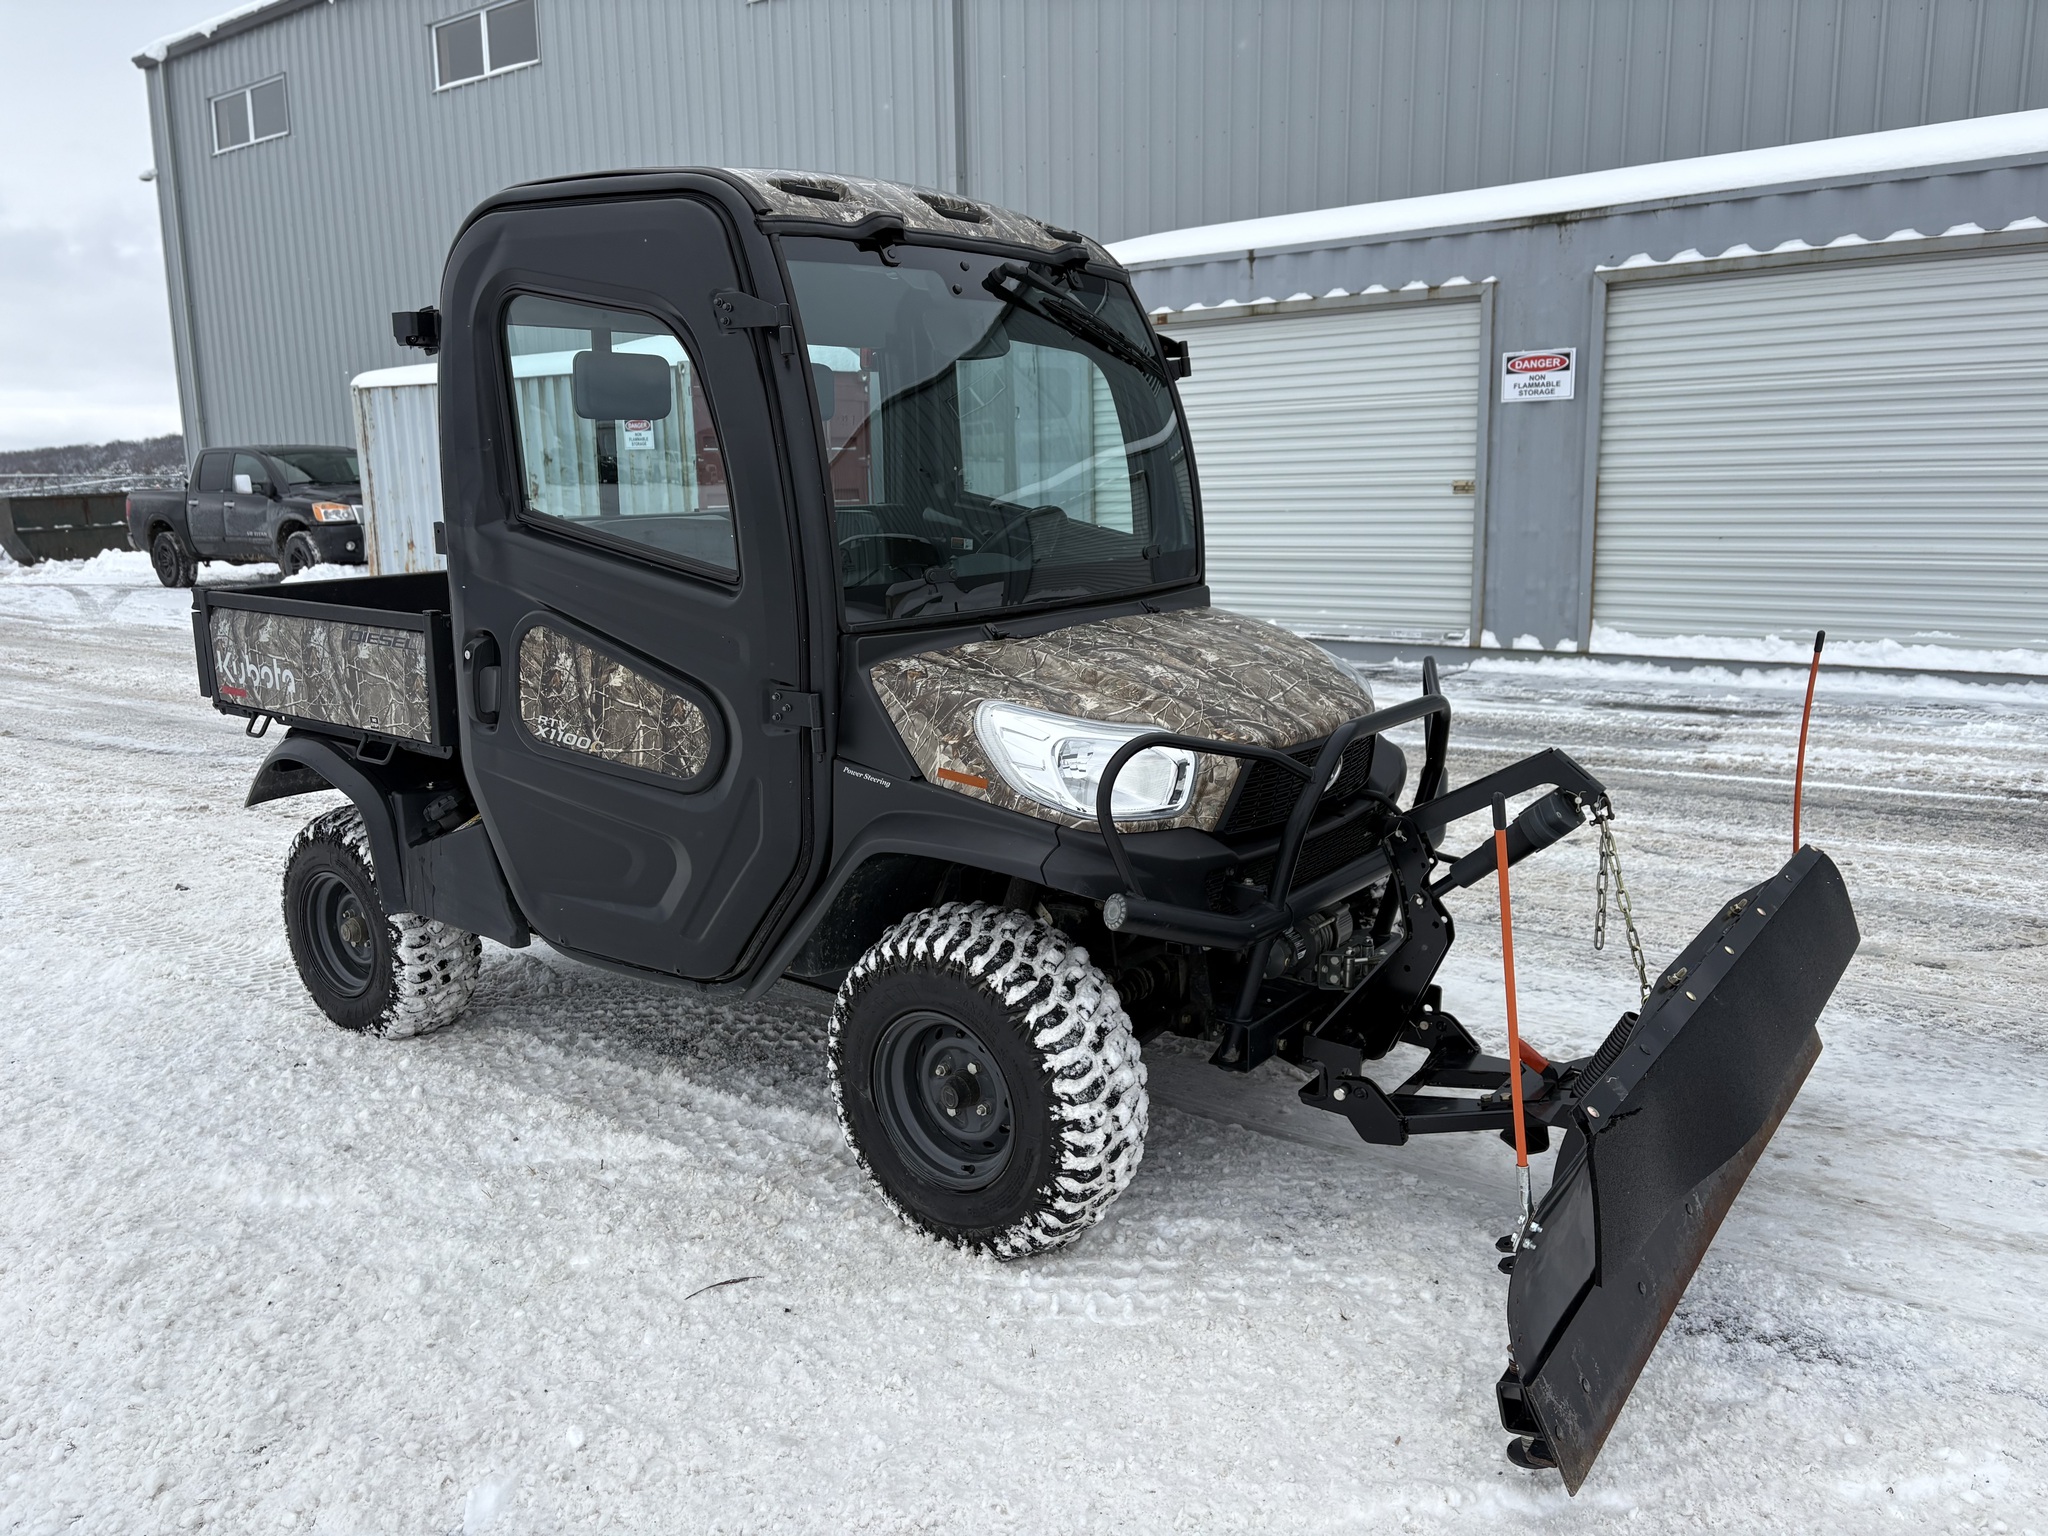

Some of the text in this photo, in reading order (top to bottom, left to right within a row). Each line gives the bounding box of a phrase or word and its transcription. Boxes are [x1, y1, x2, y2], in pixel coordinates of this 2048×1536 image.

[1515, 358, 1561, 370] DANGER
[1513, 380, 1561, 390] FLAMMABLE
[1518, 388, 1556, 397] STORAGE
[348, 630, 418, 651] DIESEL
[216, 650, 296, 694] Kubota
[538, 715, 569, 730] RTV
[535, 725, 605, 752] X1100C
[843, 766, 892, 789] Power Steering
